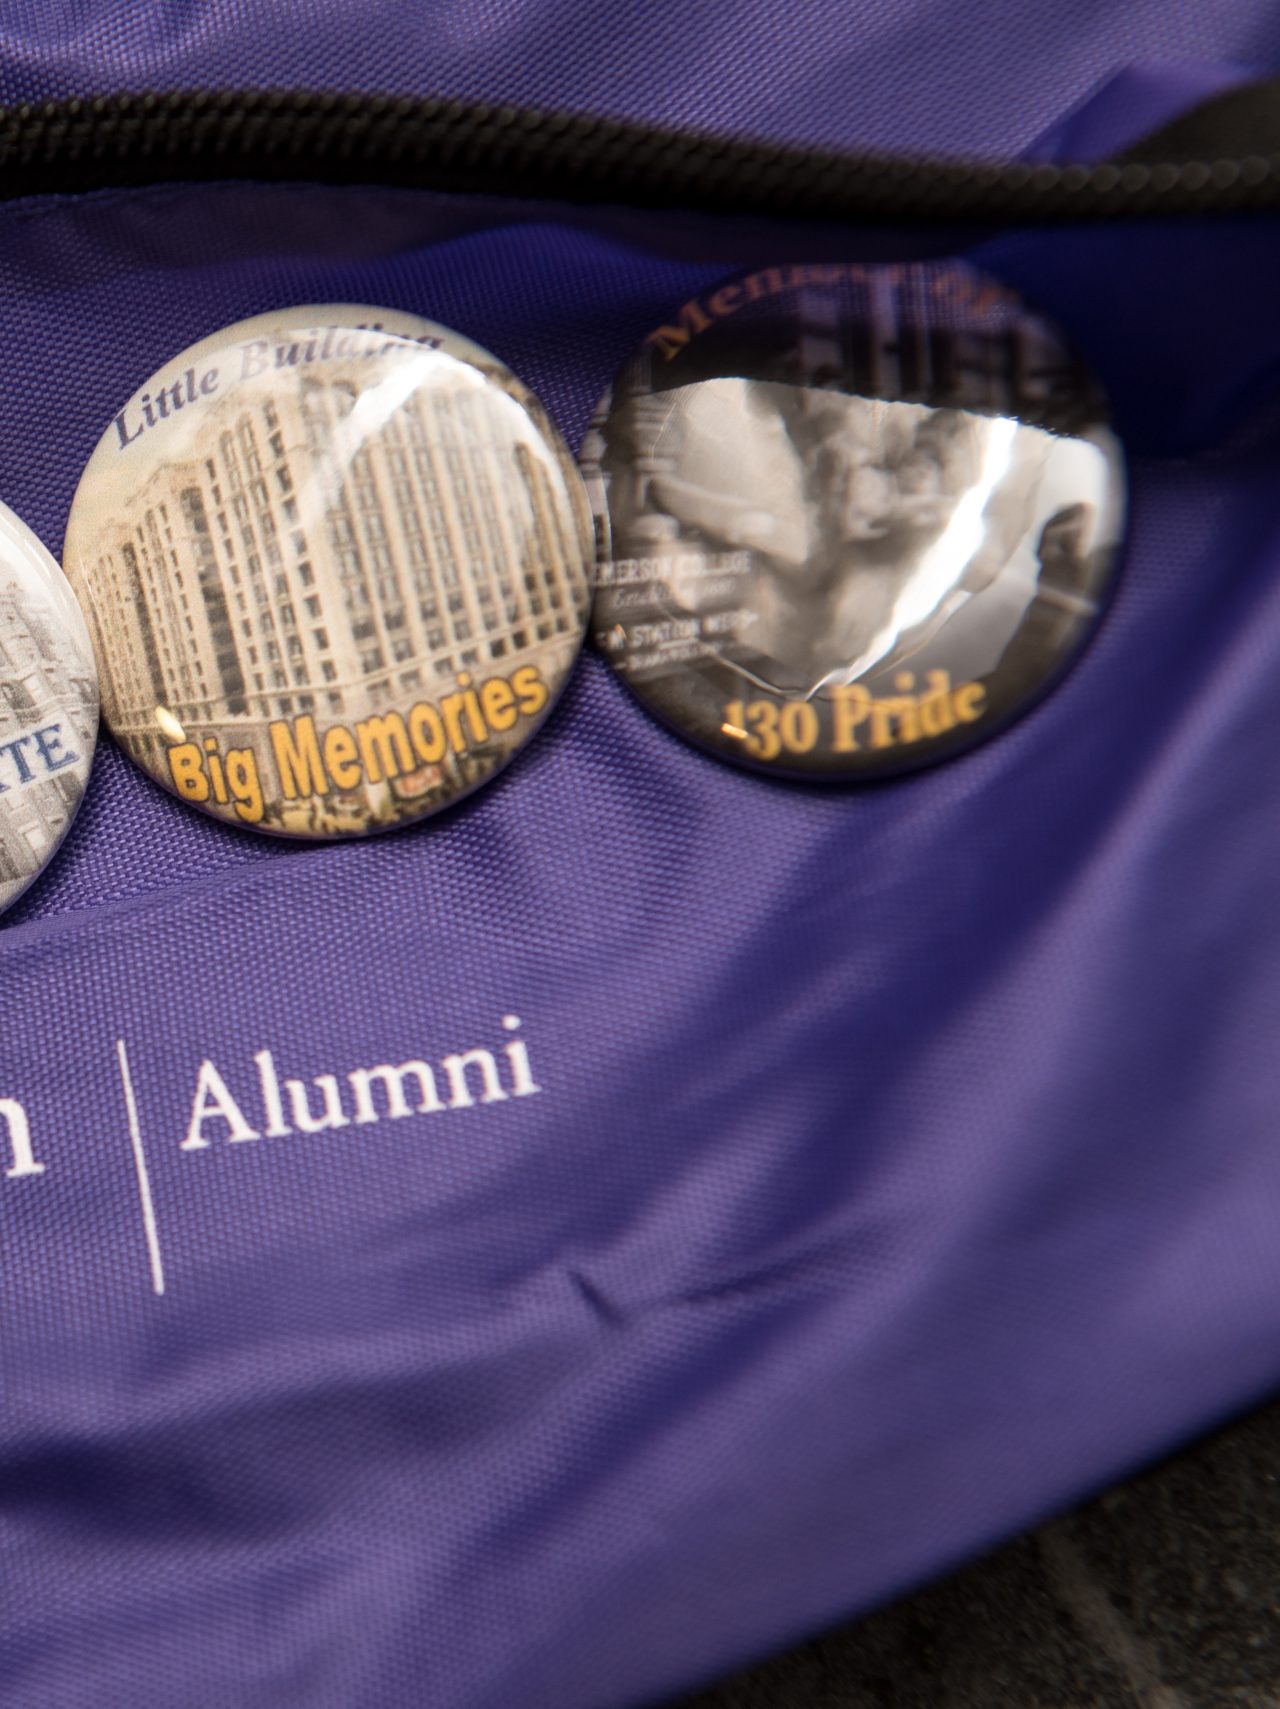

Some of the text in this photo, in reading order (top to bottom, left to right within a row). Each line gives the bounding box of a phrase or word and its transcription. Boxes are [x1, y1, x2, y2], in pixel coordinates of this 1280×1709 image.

[113, 366, 219, 450] Little
[170, 665, 548, 823] Big Memories
[722, 668, 987, 760] 130 Pride
[180, 1014, 543, 1150] Alumni
